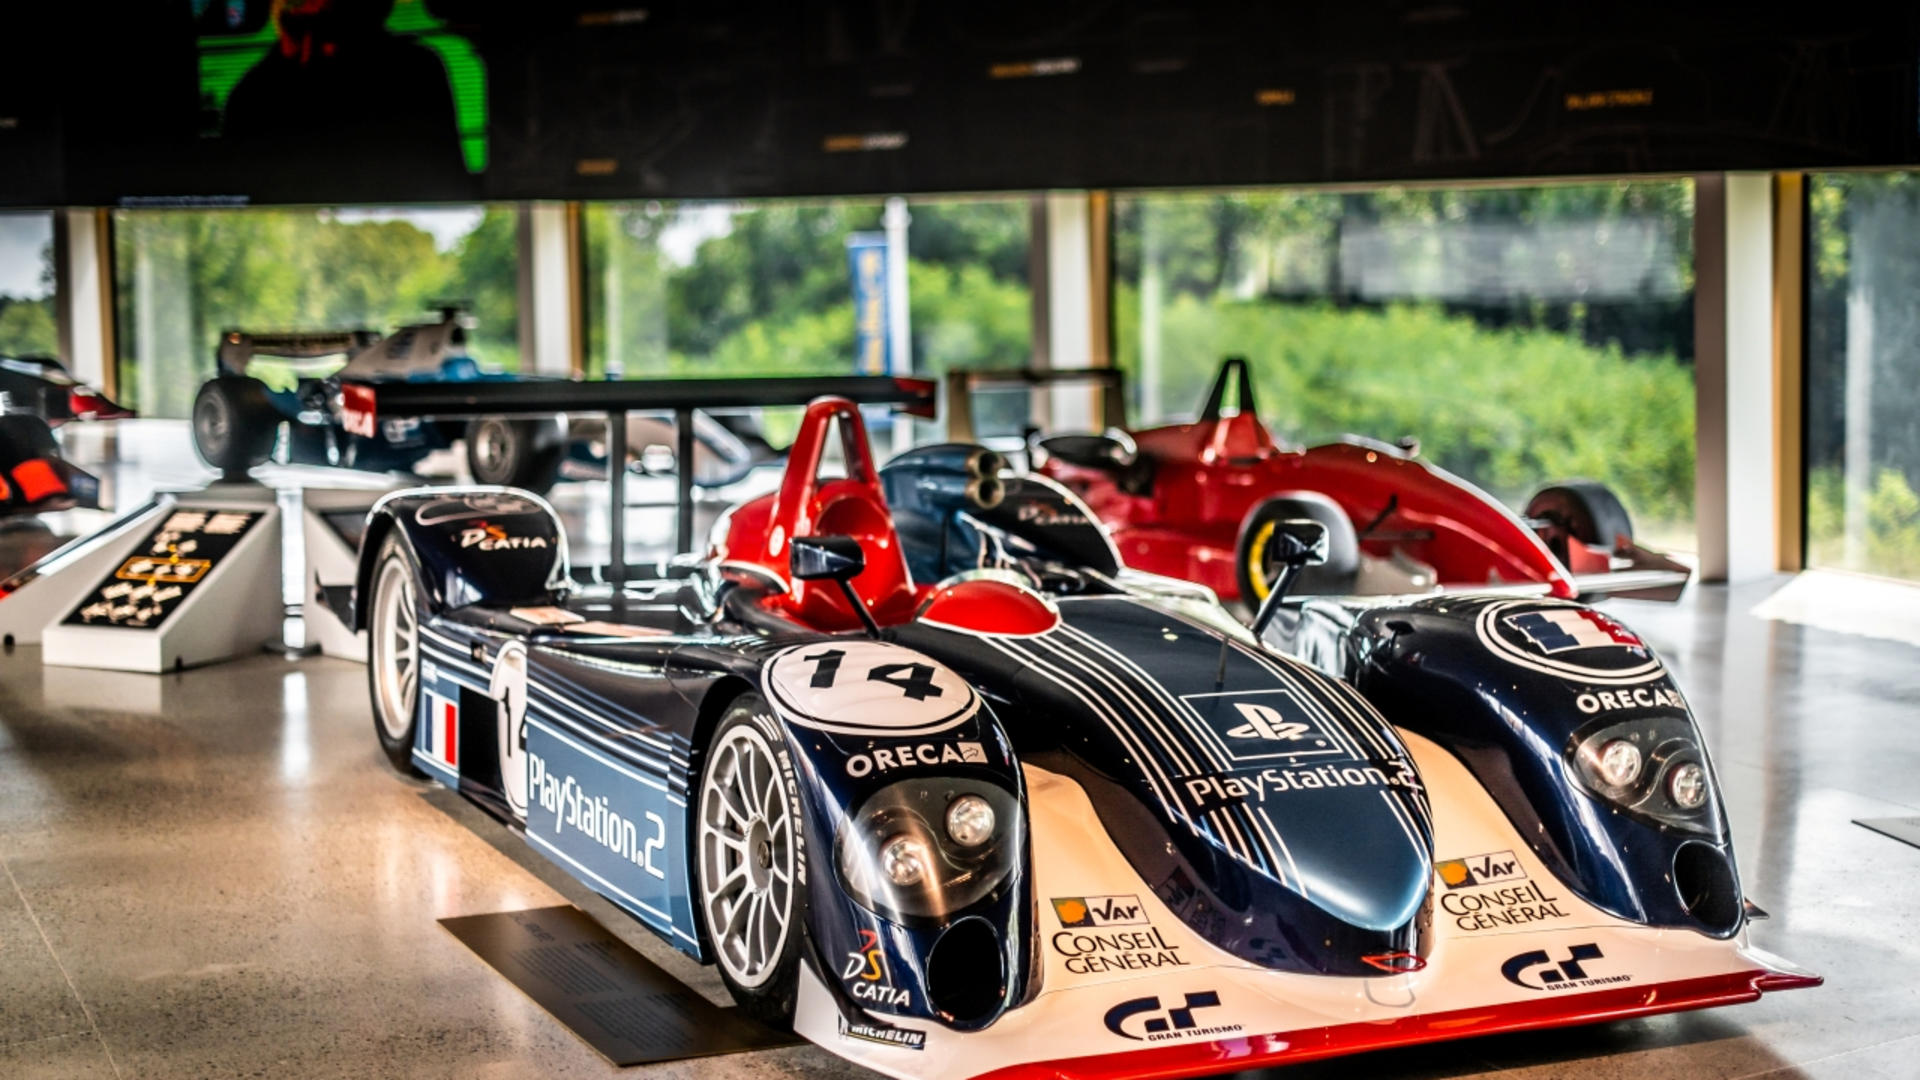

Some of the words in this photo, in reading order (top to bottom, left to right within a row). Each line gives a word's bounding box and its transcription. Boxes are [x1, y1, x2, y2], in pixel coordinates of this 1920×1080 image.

[479, 537, 547, 551] CATIA
[803, 649, 943, 702] 14
[1576, 688, 1673, 714] ORECA
[846, 743, 965, 778] ORECA
[777, 749, 807, 886] MICHELIN
[1441, 880, 1558, 916] CONSEIL
[1052, 926, 1179, 957] CONSEIL
[852, 981, 910, 1007] CATIA
[1546, 980, 1578, 991] GRAN
[1580, 974, 1632, 986] TURISMO
[851, 1024, 924, 1046] MICHELIN
[1147, 1031, 1183, 1042] GRAN
[1186, 1023, 1243, 1038] TURISMO
